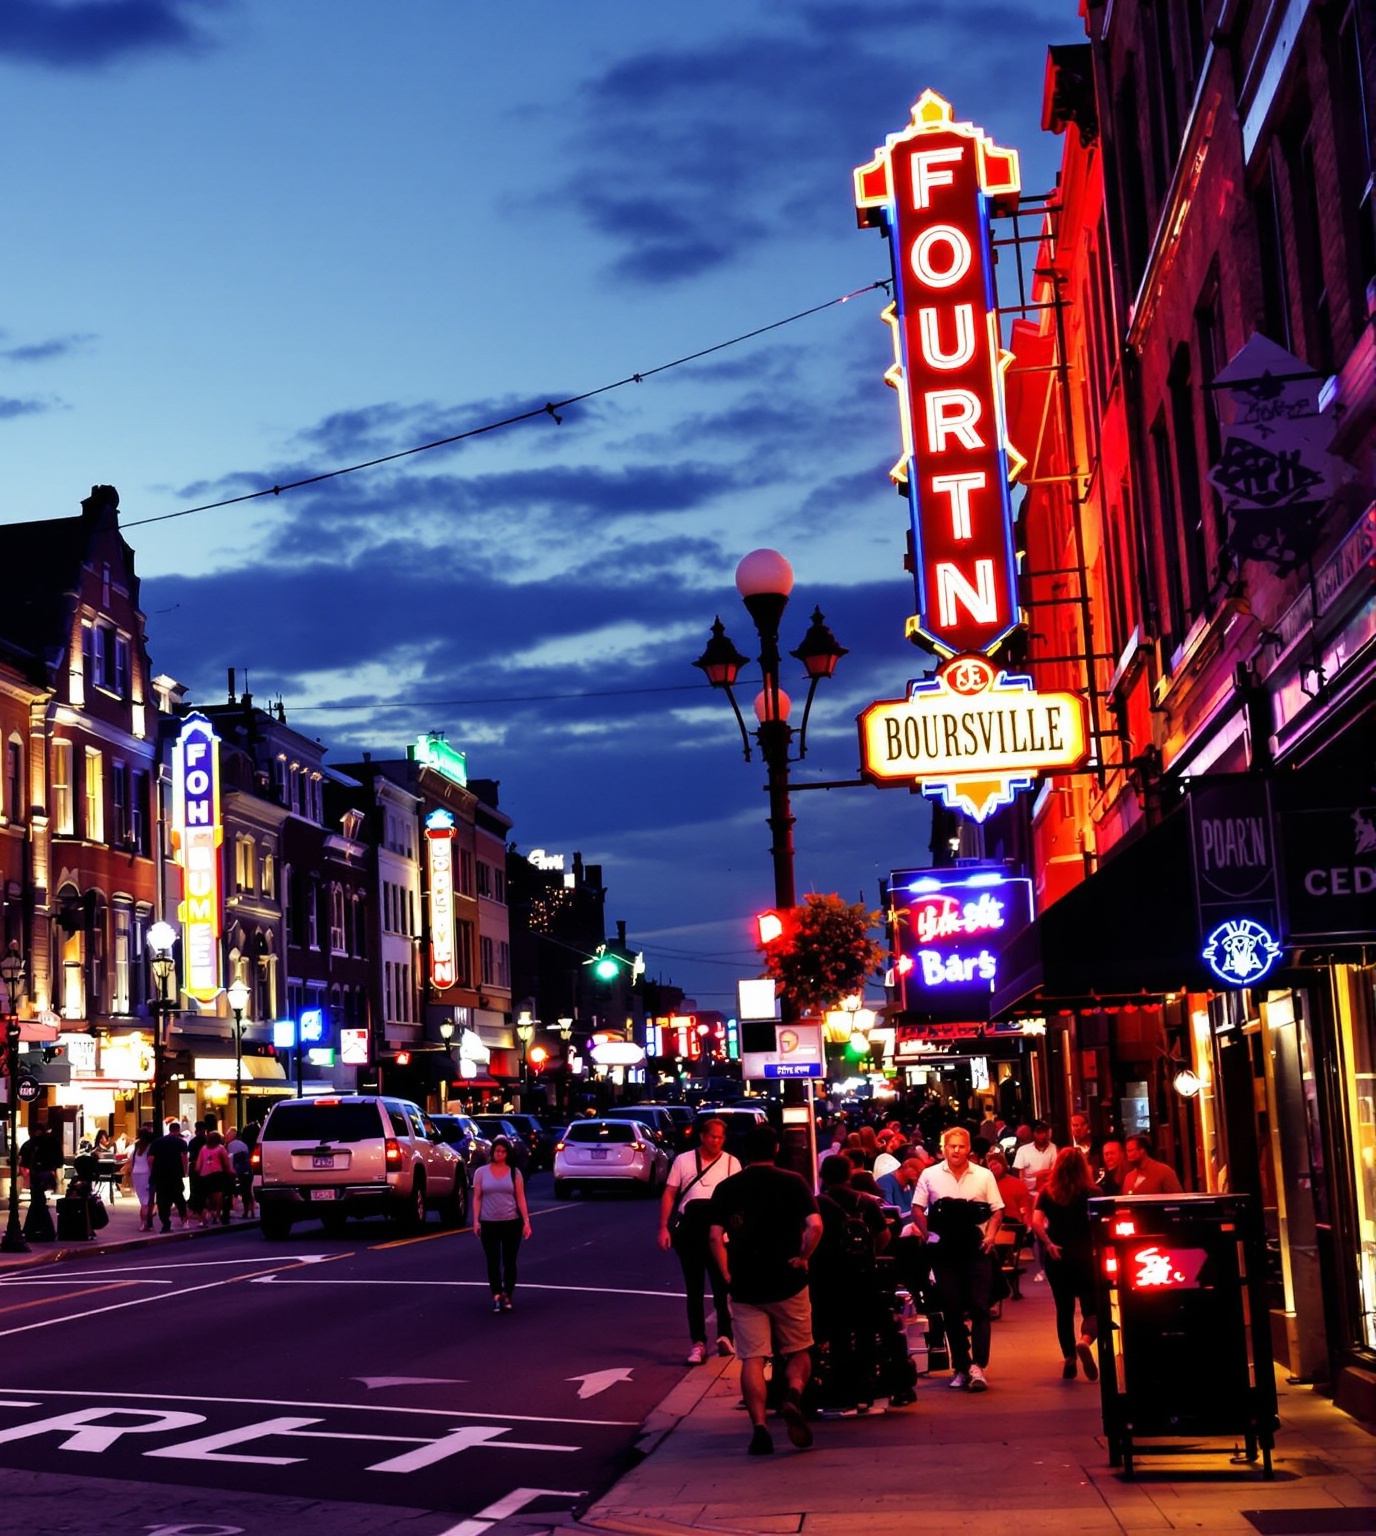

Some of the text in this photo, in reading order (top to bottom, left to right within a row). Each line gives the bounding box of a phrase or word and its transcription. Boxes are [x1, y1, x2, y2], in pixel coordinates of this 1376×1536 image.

[909, 145, 999, 628] FOURTN
[884, 704, 1064, 762] BOURSVILLE
[918, 950, 997, 986] Bars
